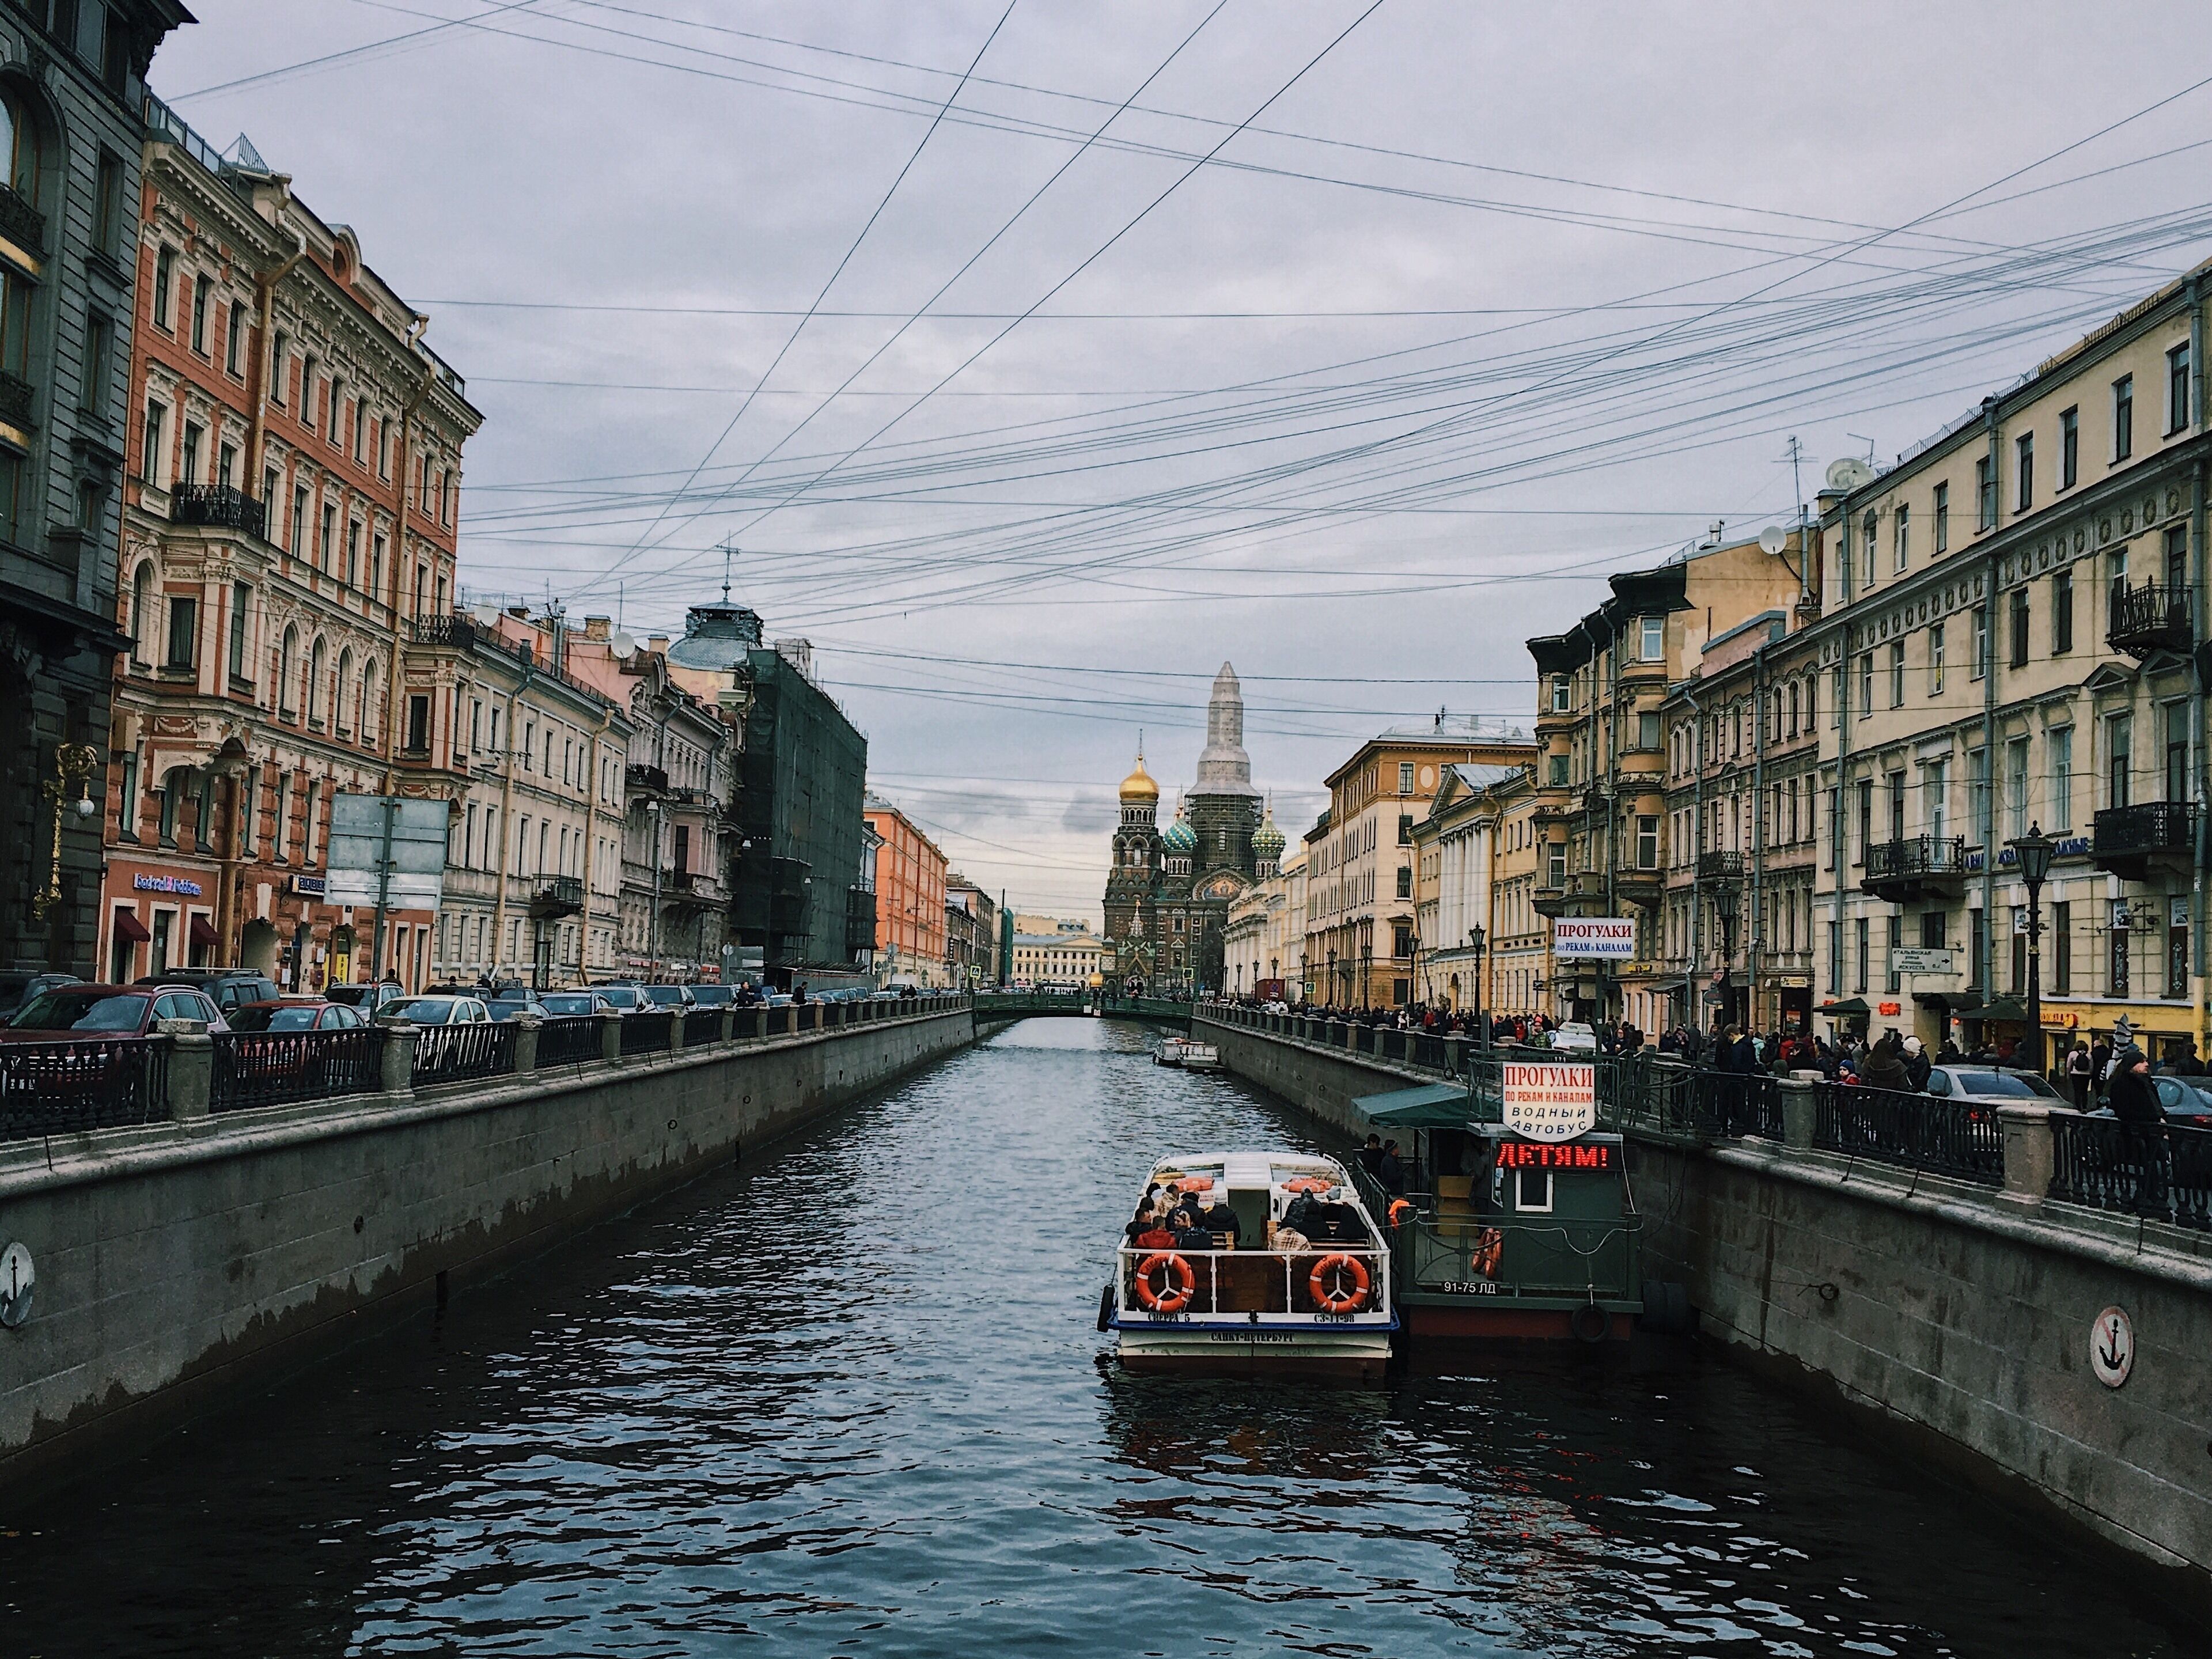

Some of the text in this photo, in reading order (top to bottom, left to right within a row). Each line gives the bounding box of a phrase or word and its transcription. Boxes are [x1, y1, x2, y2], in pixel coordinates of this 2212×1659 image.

[1557, 925, 1632, 937] ПРОГУЛКИ
[1566, 942, 1590, 951] РЕКАМ
[1596, 943, 1632, 952] КАНАЛАМ
[1505, 1067, 1593, 1087] ПРОГУЛКИ
[1505, 1091, 1592, 1103] ПО РЕКАМ И КАНАЛАМ
[1512, 1106, 1586, 1119] ВОДНЫЙ
[1512, 1120, 1587, 1134] АВТОБУС
[1444, 1281, 1496, 1294] 91-75 ЛД
[1184, 1313, 1190, 1322] 5
[1211, 1332, 1295, 1343] САНКТ-ПЕТЕРБУРГ
